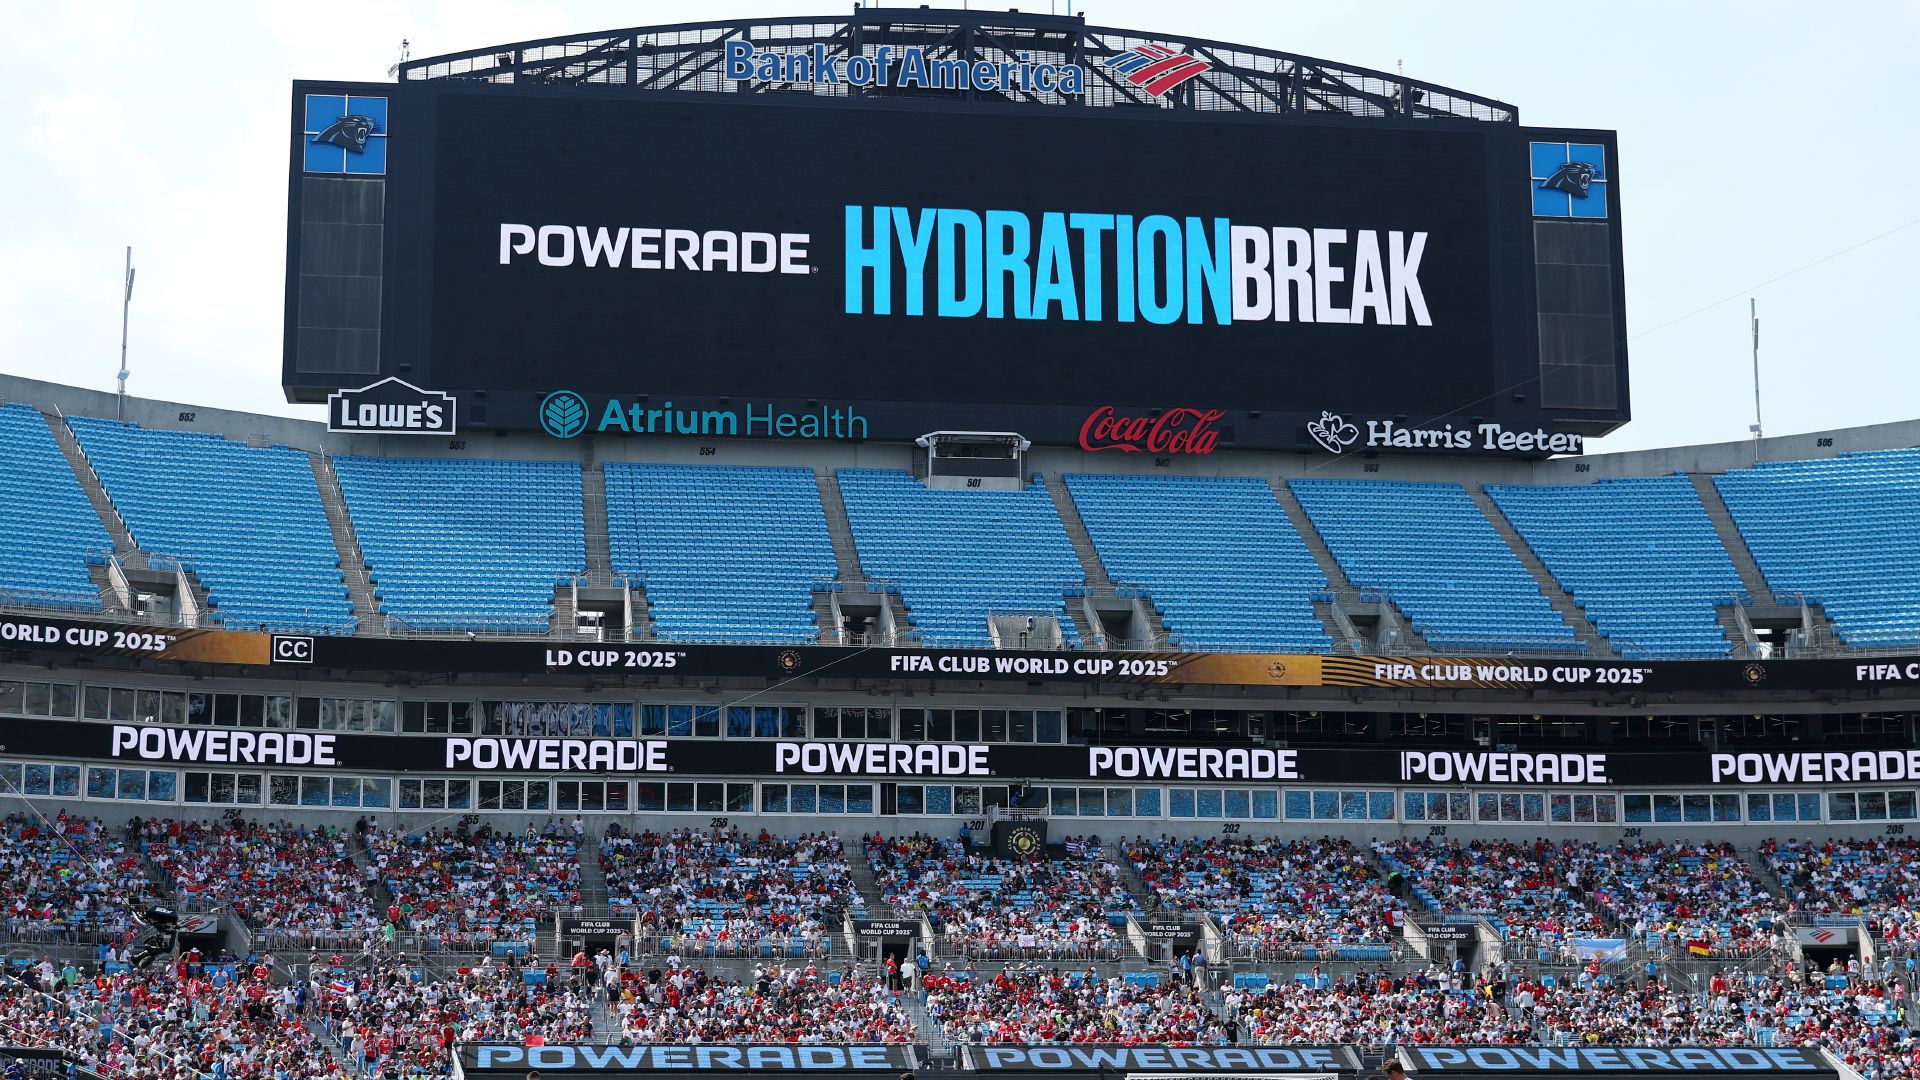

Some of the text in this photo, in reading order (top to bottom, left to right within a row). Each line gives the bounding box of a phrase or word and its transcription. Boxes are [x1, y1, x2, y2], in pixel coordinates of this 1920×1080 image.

[724, 40, 1085, 95] Bank of America
[179, 413, 196, 422] 552
[598, 399, 868, 440] Atrium Health
[1078, 405, 1226, 455] Coca-Cola
[1365, 419, 1583, 453] Harris Teeter
[699, 447, 716, 456] 554
[1817, 438, 1833, 447] 505
[1575, 464, 1590, 473] 504
[967, 478, 982, 488] 501
[0, 622, 60, 643] ORLD
[65, 627, 109, 647] CUP
[278, 639, 308, 659] CC
[577, 650, 619, 667] CUP
[890, 655, 934, 671] FIFA
[938, 656, 990, 673] CLUB
[995, 658, 1069, 674] WORLD
[1073, 659, 1114, 675] CUP
[1375, 663, 1417, 680] FIFA
[1421, 664, 1472, 681] CLUB
[1477, 665, 1548, 682] WORLD
[1552, 667, 1591, 683] CUP
[1856, 663, 1920, 681] FIFA C
[1711, 750, 1920, 783] POWERADE
[970, 820, 985, 830] 201
[1222, 823, 1241, 834] 202
[1429, 825, 1447, 836] 203
[1624, 827, 1642, 838] 204
[1885, 824, 1904, 835] 205
[984, 1047, 1341, 1068] POWERADE
[1418, 1048, 1817, 1069] POWERADE
